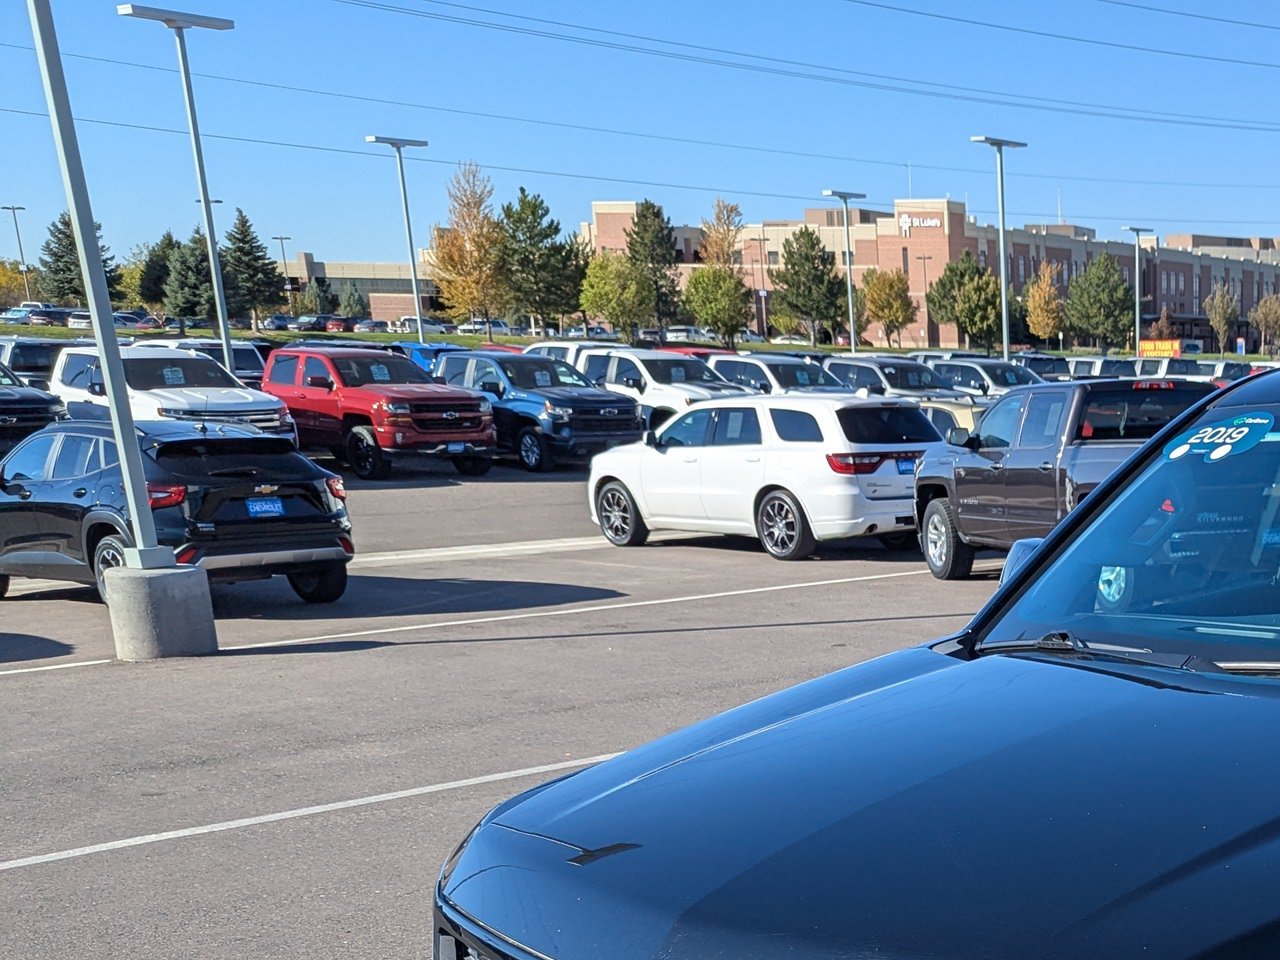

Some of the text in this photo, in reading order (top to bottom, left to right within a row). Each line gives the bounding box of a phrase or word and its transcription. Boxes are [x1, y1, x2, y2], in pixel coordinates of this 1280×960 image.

[912, 217, 920, 227] St
[1187, 426, 1249, 444] 2019
[248, 502, 282, 513] CHEVROLET
